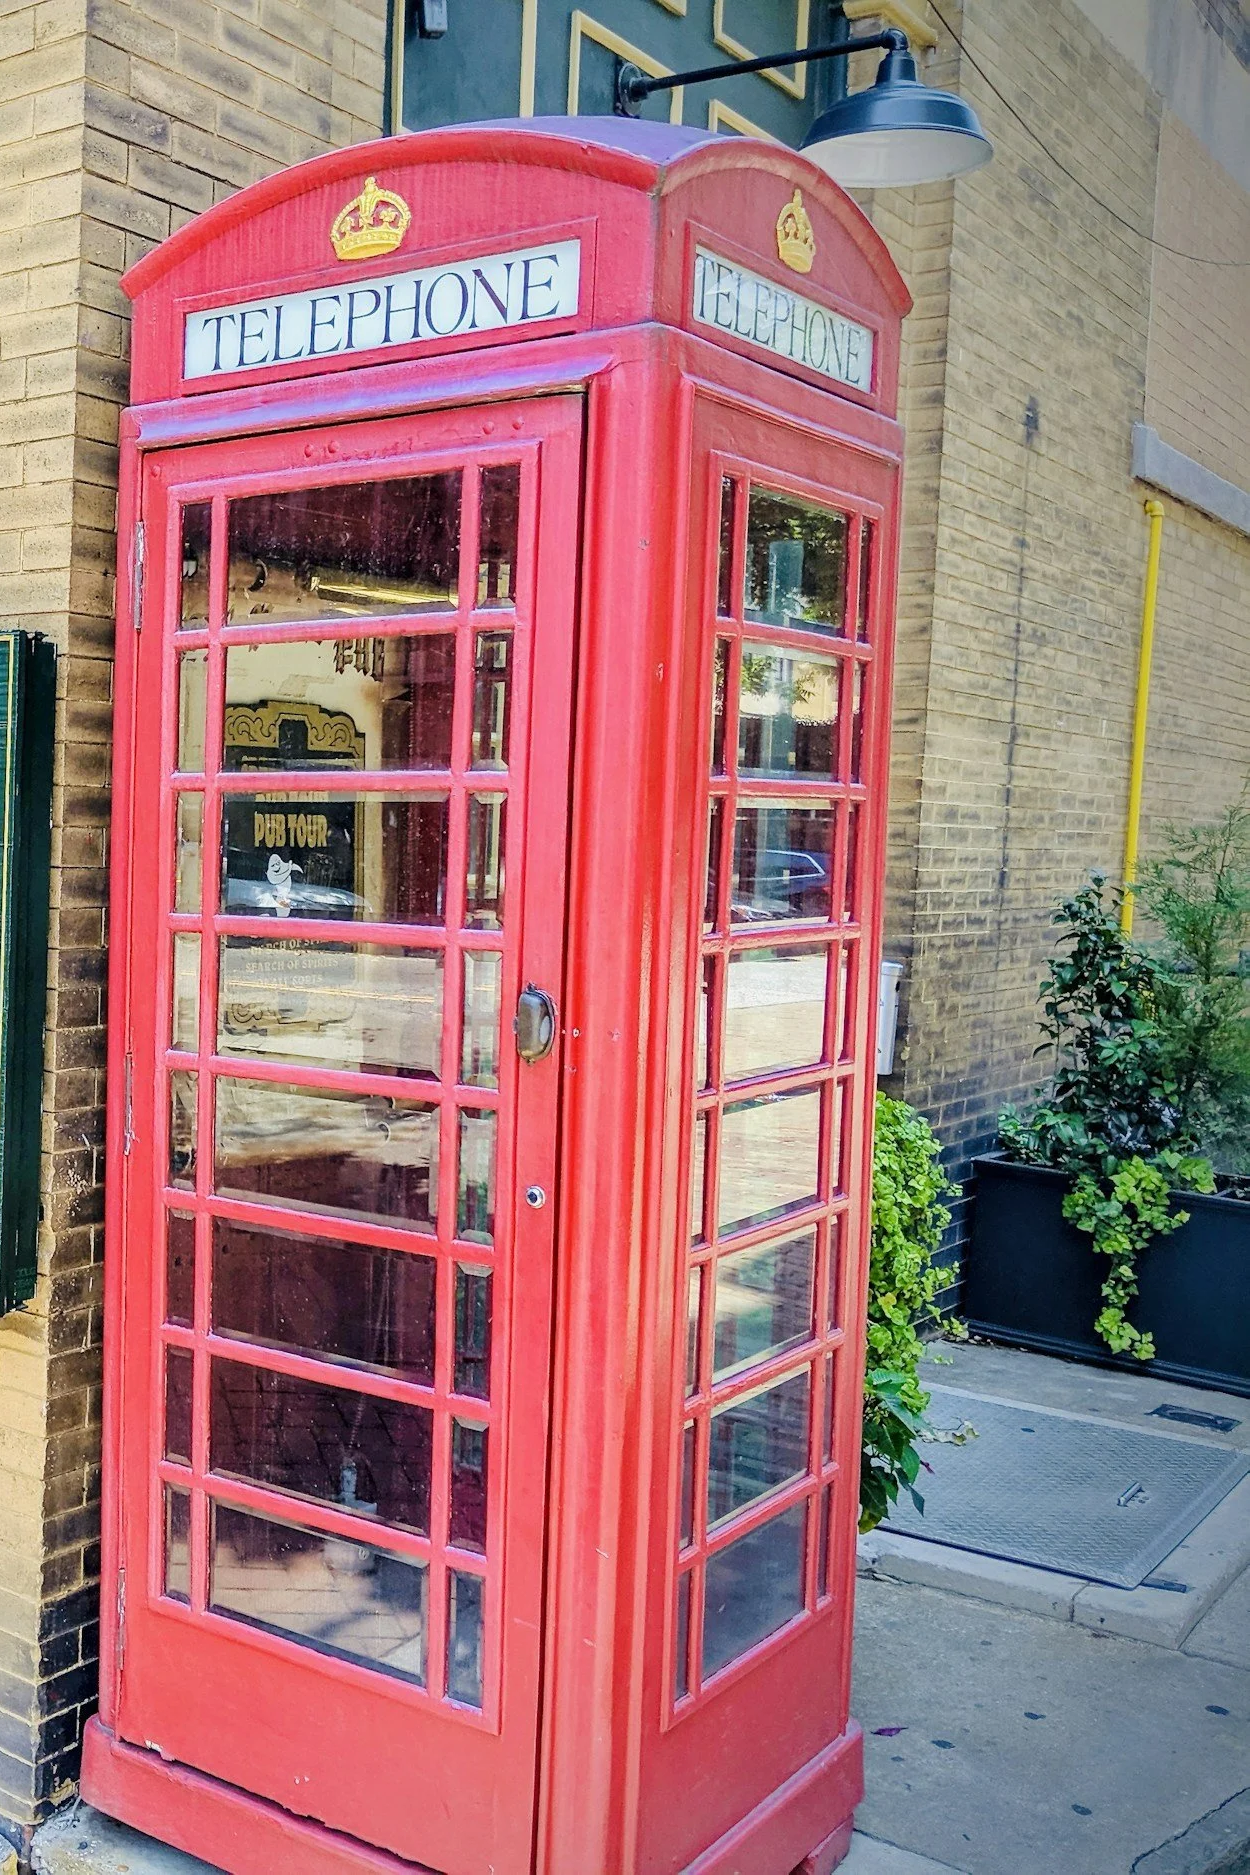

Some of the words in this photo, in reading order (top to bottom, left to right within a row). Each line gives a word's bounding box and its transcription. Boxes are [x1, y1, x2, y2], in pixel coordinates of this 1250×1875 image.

[202, 254, 561, 372] TELEPHONE
[695, 253, 862, 386] TELEPHONE
[254, 813, 287, 848] PUB
[287, 813, 328, 848] TOUR
[245, 961, 285, 973] SEARCH
[286, 959, 298, 970] OF
[301, 958, 339, 969] SPIRITS
